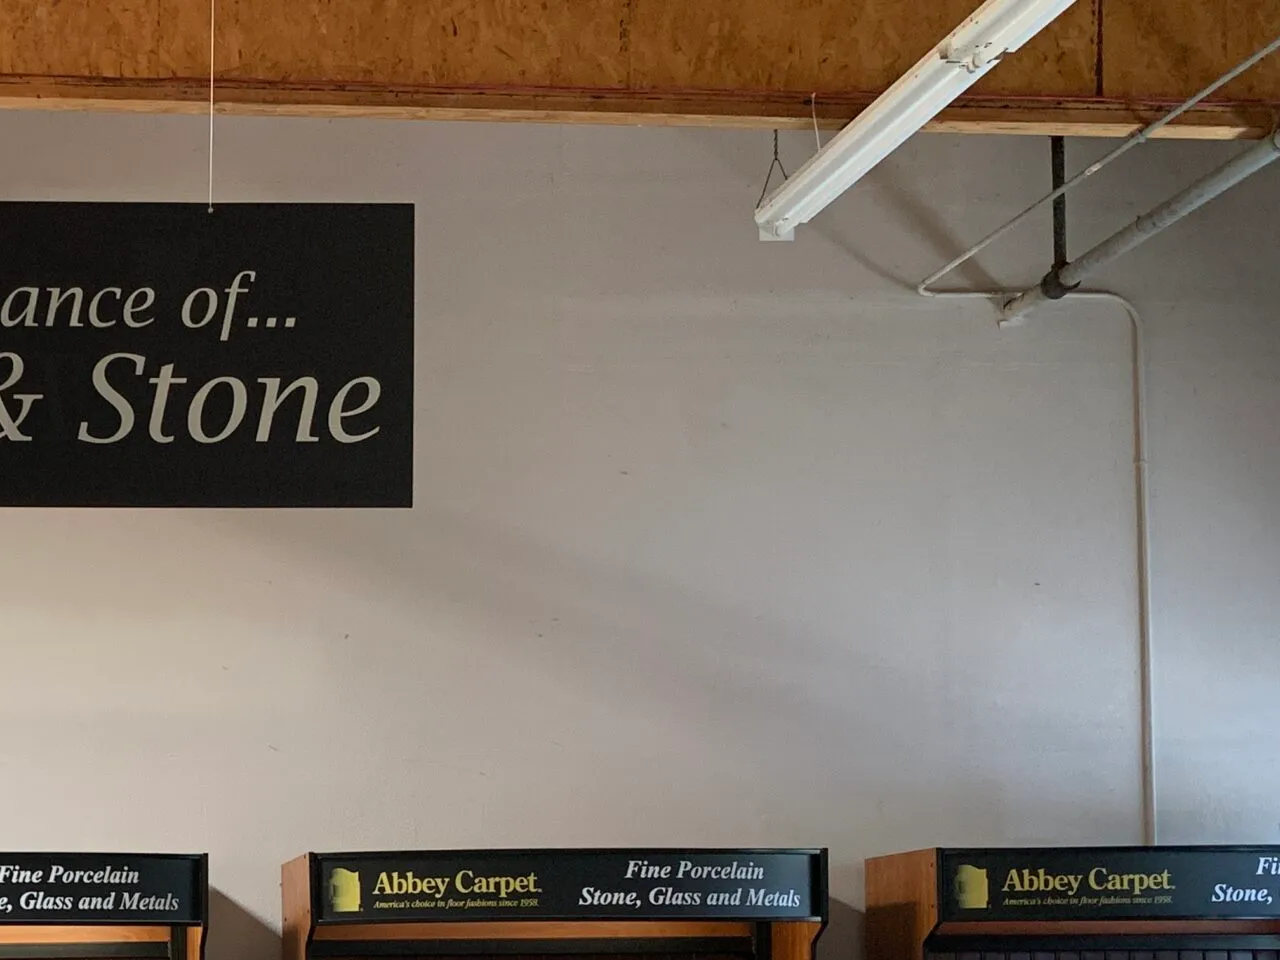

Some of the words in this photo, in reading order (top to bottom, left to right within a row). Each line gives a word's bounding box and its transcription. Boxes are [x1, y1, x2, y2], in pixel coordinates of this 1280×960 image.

[179, 269, 300, 342] of...
[77, 352, 383, 445] Stone
[47, 865, 140, 884] Porcelain
[624, 860, 672, 880] Fine
[676, 860, 765, 881] Porcelain
[1001, 868, 1083, 895] Abbey
[372, 871, 450, 898] Abbey
[1210, 883, 1273, 904] Stone,
[18, 891, 73, 911] Glass
[77, 891, 115, 911] and
[119, 891, 180, 911] Metals
[373, 900, 410, 909] America's
[411, 900, 436, 909] choice
[437, 900, 446, 909] in
[446, 899, 465, 910] floor
[464, 899, 498, 910] fashions
[498, 899, 519, 908] since
[578, 886, 642, 909] Stone,
[648, 886, 702, 907] Glass
[706, 886, 742, 908] and
[744, 887, 802, 909] Metals
